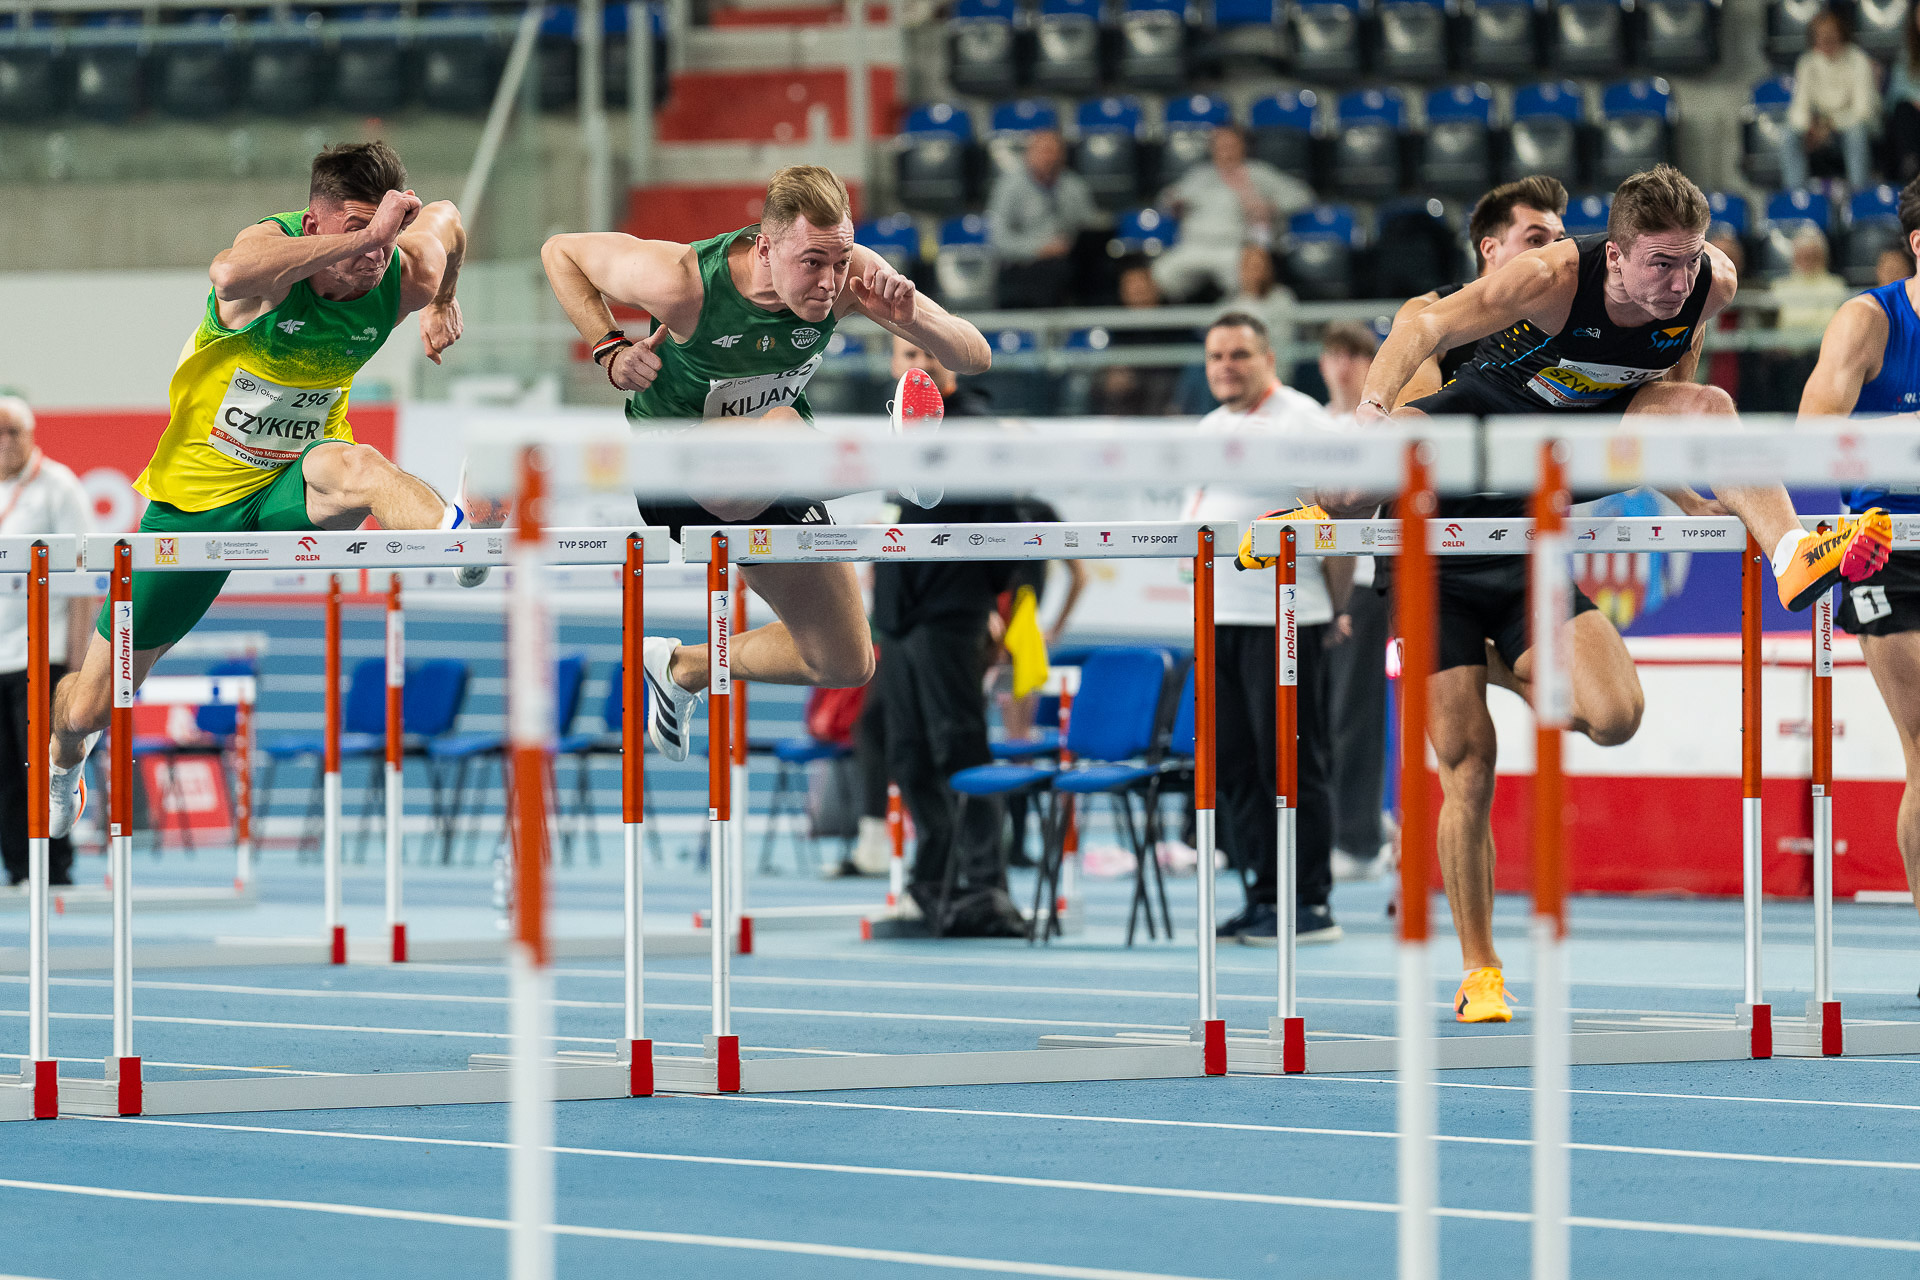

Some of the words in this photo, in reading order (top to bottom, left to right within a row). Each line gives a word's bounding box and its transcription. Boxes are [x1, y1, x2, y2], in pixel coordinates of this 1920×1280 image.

[276, 319, 306, 335] 4F
[711, 334, 743, 348] 4F
[290, 392, 332, 409] 296
[721, 385, 800, 417] KILJAN
[224, 406, 320, 440] CZYKIER
[235, 448, 269, 467] TORUŃ
[930, 533, 952, 546] 4F
[1132, 535, 1149, 544] TVP
[1150, 535, 1179, 544] SPORT
[1488, 528, 1508, 541] 4F
[1681, 529, 1699, 538] TVP
[1699, 529, 1726, 538] SPORT
[345, 541, 368, 554] 4F
[558, 540, 577, 549] TVP
[578, 540, 608, 549] SPORT
[750, 544, 771, 554] PZLA
[881, 545, 906, 553] ORLEN
[1315, 541, 1336, 549] PZLA
[156, 554, 178, 564] PZLA
[294, 554, 321, 562] ORLEN
[1863, 590, 1880, 615] 1
[1820, 601, 1832, 652] polanik
[1284, 608, 1297, 660] polanik
[716, 615, 729, 669] polanik
[119, 627, 132, 681] polanik
